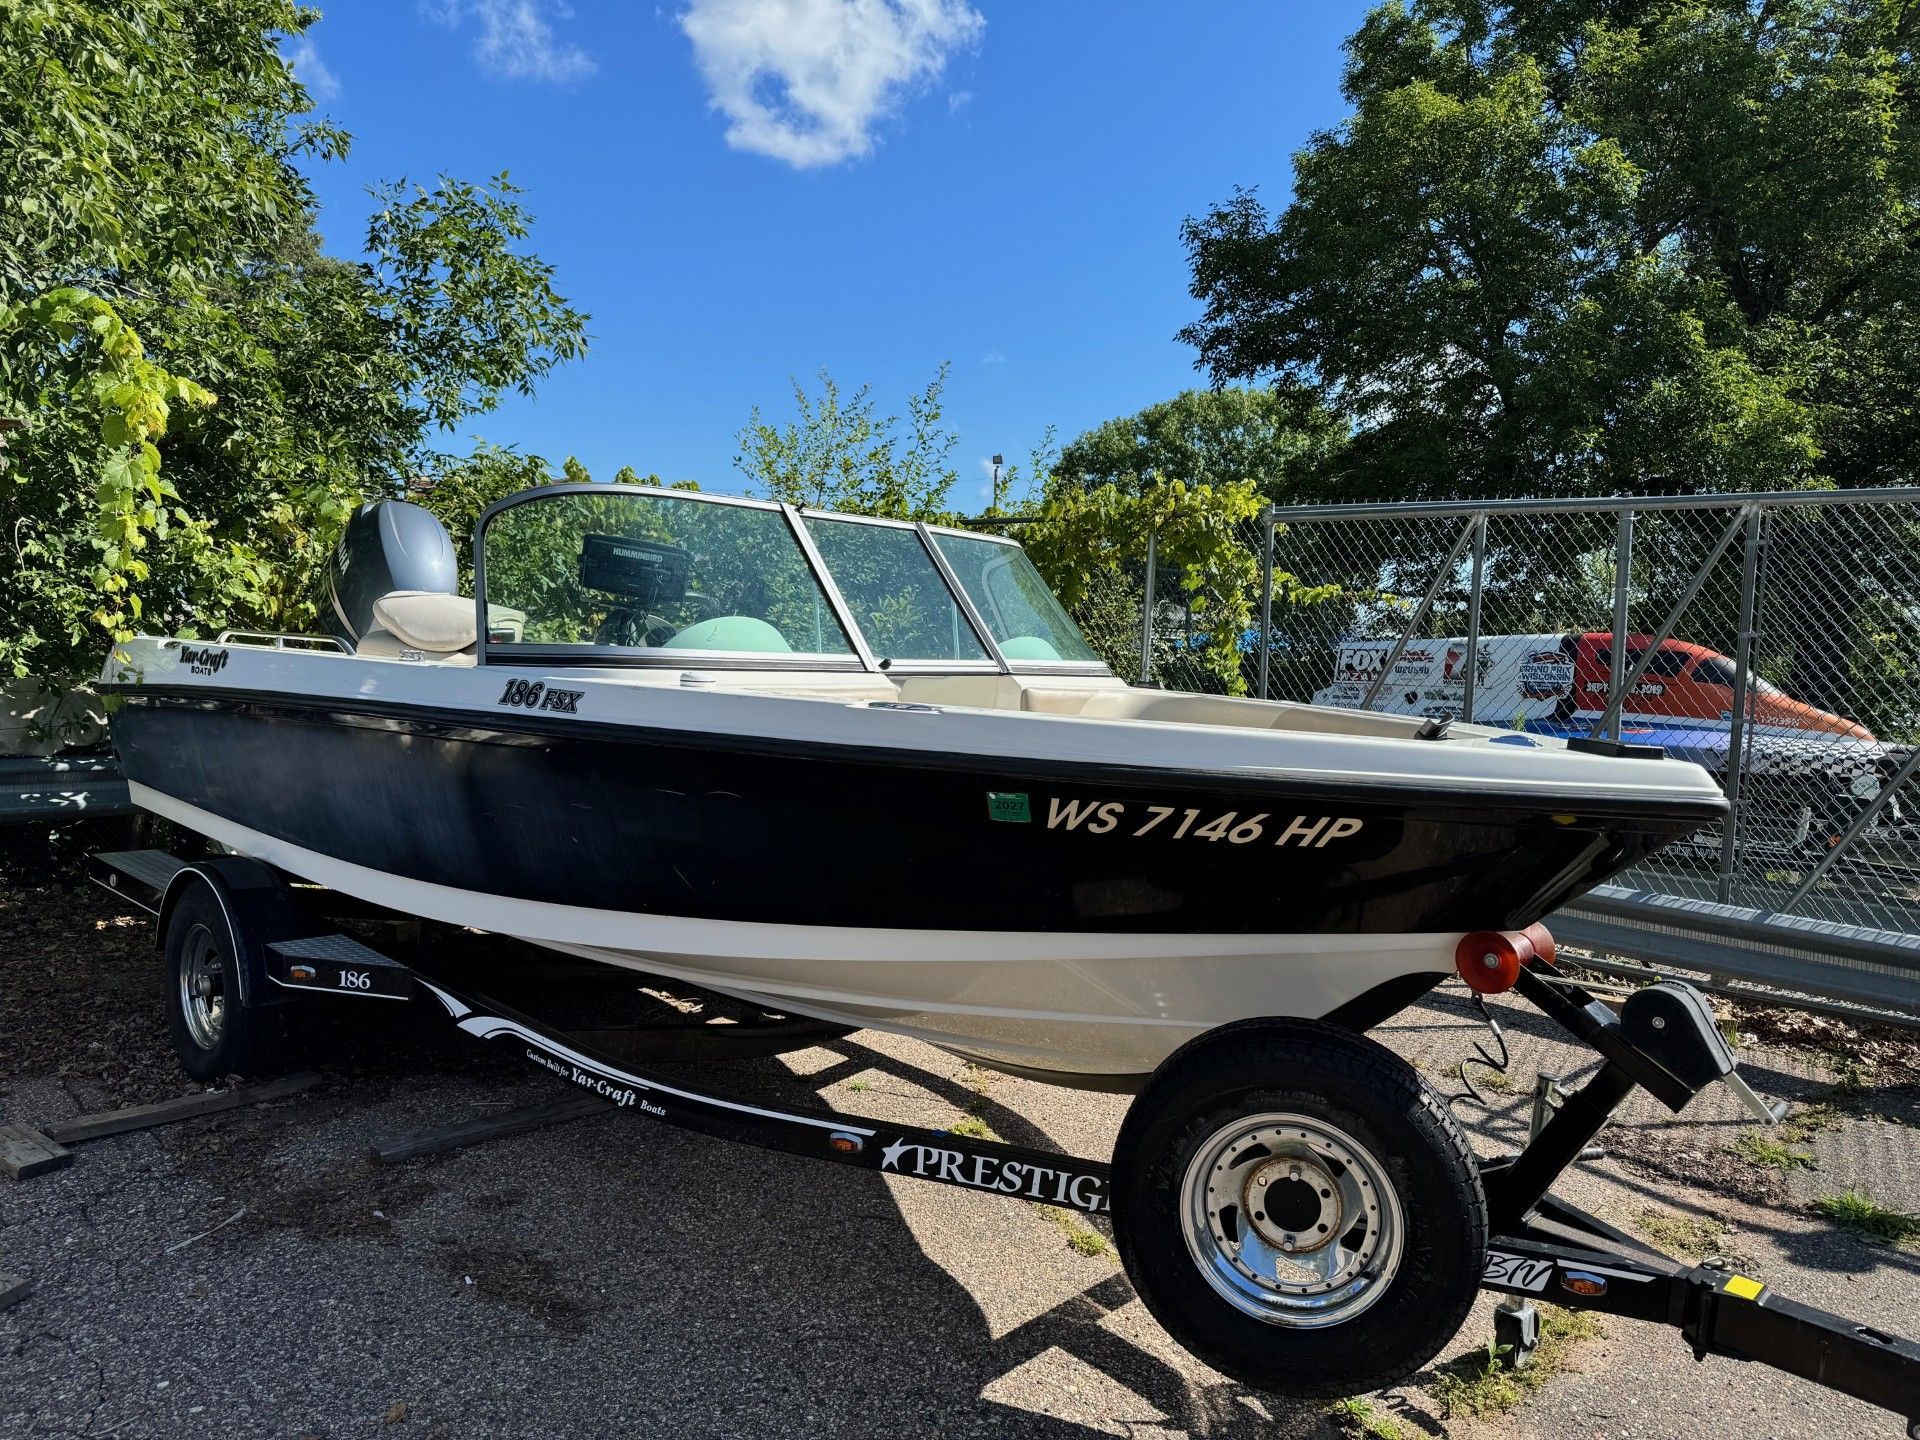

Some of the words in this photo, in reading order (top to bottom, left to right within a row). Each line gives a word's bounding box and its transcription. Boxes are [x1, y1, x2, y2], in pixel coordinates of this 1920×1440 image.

[613, 547, 663, 562] HUMMINBIRD
[1340, 649, 1386, 671] FOX
[1520, 665, 1549, 674] GRAND
[1551, 666, 1571, 674] PRIX
[191, 665, 212, 676] BOATS
[1522, 673, 1571, 681] WISCONSIN
[498, 678, 545, 708] 186
[539, 688, 585, 714] FSX
[994, 800, 1024, 810] 2027
[1046, 798, 1124, 834] WS
[1132, 806, 1271, 844] 7146
[1274, 815, 1363, 848] HP
[338, 970, 371, 989] 186
[526, 1049, 546, 1066] Custom
[547, 1059, 560, 1073] Built
[559, 1066, 569, 1077] for
[571, 1067, 636, 1107] Yar-Craft
[640, 1100, 666, 1116] Boats
[912, 1145, 1110, 1212] PRESTIG
